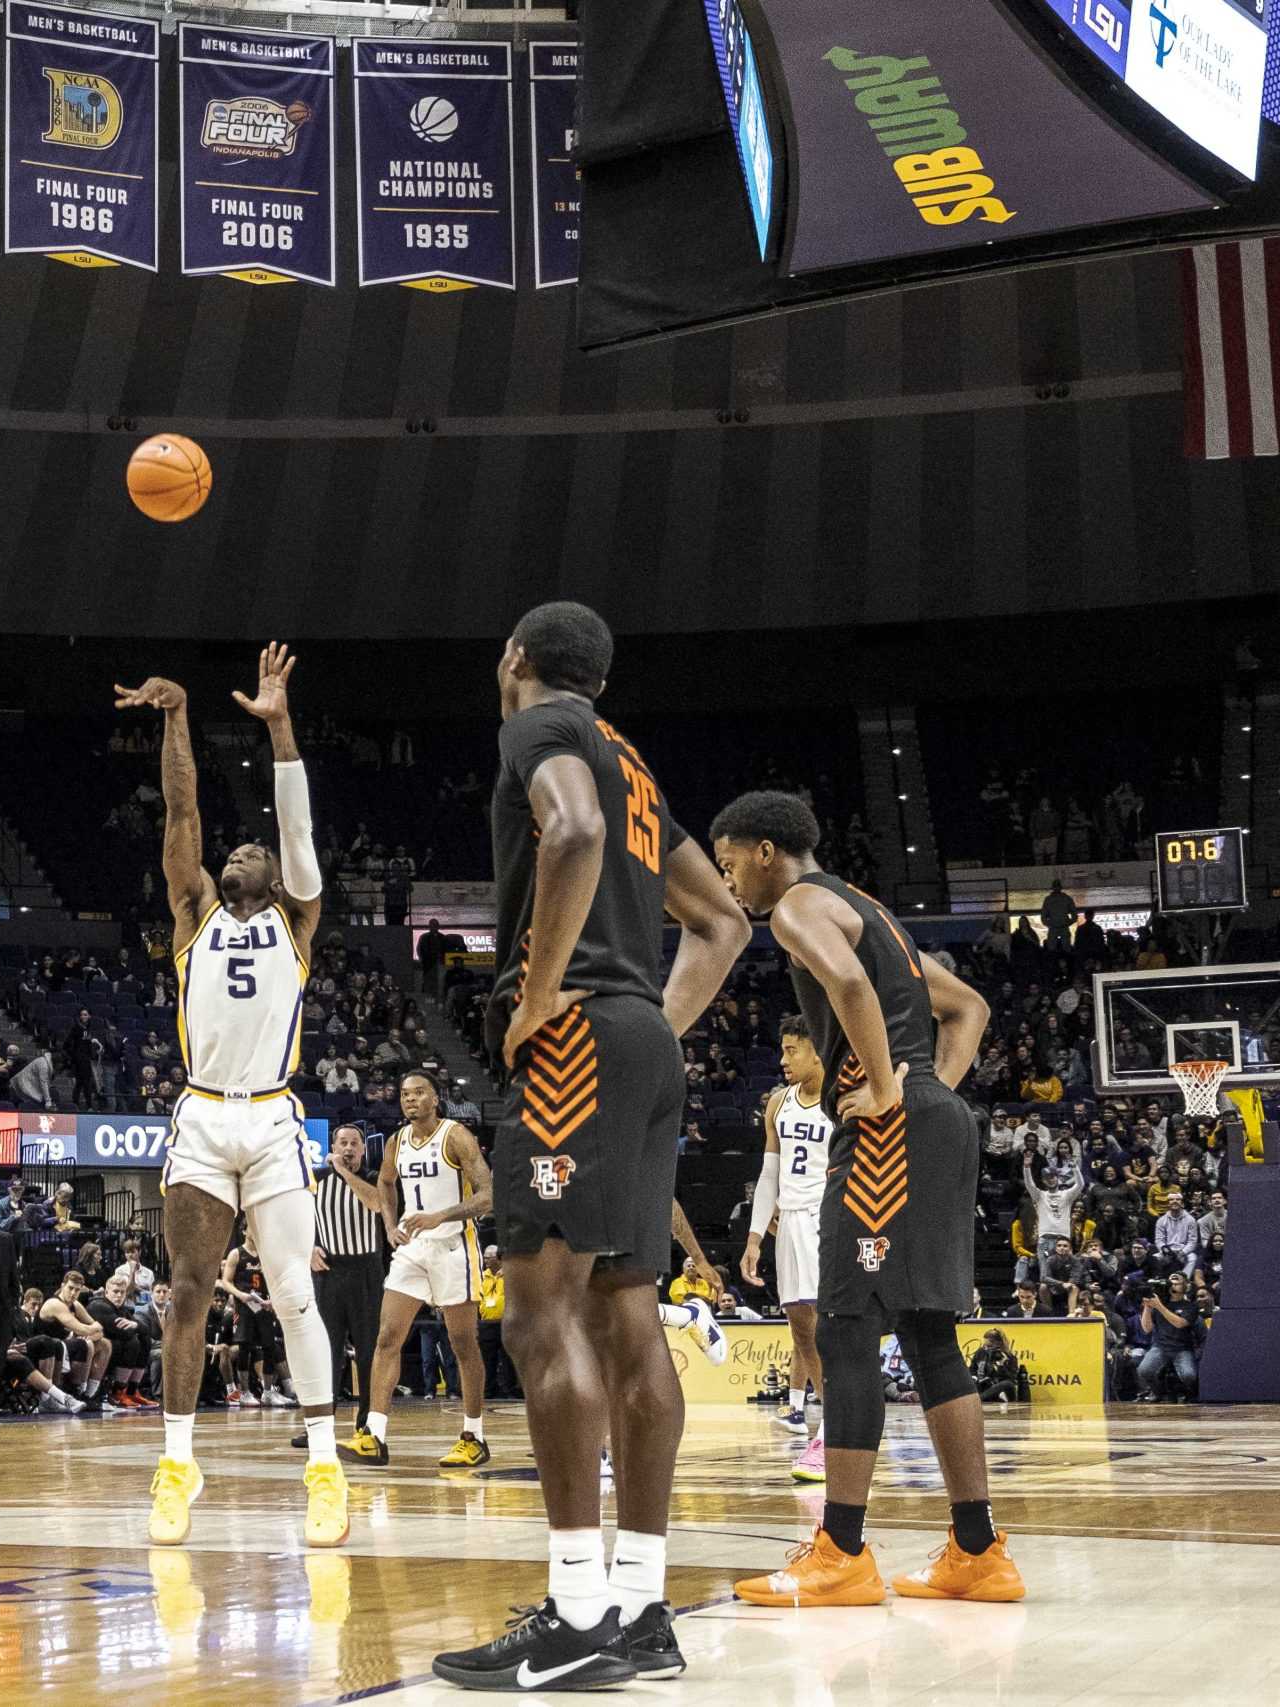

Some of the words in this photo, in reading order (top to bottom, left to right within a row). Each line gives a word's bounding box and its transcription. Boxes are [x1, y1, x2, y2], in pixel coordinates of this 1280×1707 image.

[28, 15, 65, 31] MEN'S
[68, 22, 138, 43] BASKETBALL
[1084, 0, 1123, 53] LSU
[201, 38, 237, 53] MEN'S
[241, 42, 313, 60] BASKETBALL
[376, 52, 413, 64] MEN'S
[417, 53, 489, 66] BASKETBALL
[552, 55, 579, 66] MEN
[63, 74, 100, 89] NCAA
[239, 101, 269, 111] 2006
[230, 110, 289, 128] FINAL
[209, 122, 288, 145] FOUR
[821, 46, 1018, 225] SUBWAY
[389, 160, 482, 179] NATIONAL
[36, 178, 81, 199] FINAL
[86, 185, 128, 206] FOUR
[379, 180, 494, 199] CHAMPIONS
[50, 201, 114, 234] 1986
[211, 198, 256, 218] FINAL
[262, 202, 304, 222] FOUR
[222, 220, 293, 250] 2006
[403, 223, 469, 249] 1935
[565, 230, 578, 239] CO
[73, 255, 92, 264] LSU
[249, 272, 268, 281] LSU
[618, 754, 660, 874] 25
[1167, 839, 1218, 863] 07.6
[209, 925, 278, 952] LSU
[227, 957, 257, 999] 5
[227, 1091, 248, 1099] LSU
[94, 1124, 166, 1157] 0:07
[780, 1121, 825, 1143] LSU
[400, 1161, 438, 1178] LSU
[791, 1146, 808, 1175] 2
[414, 1184, 424, 1210] 1
[728, 1373, 751, 1385] OF
[1029, 1374, 1082, 1386] SIANA
